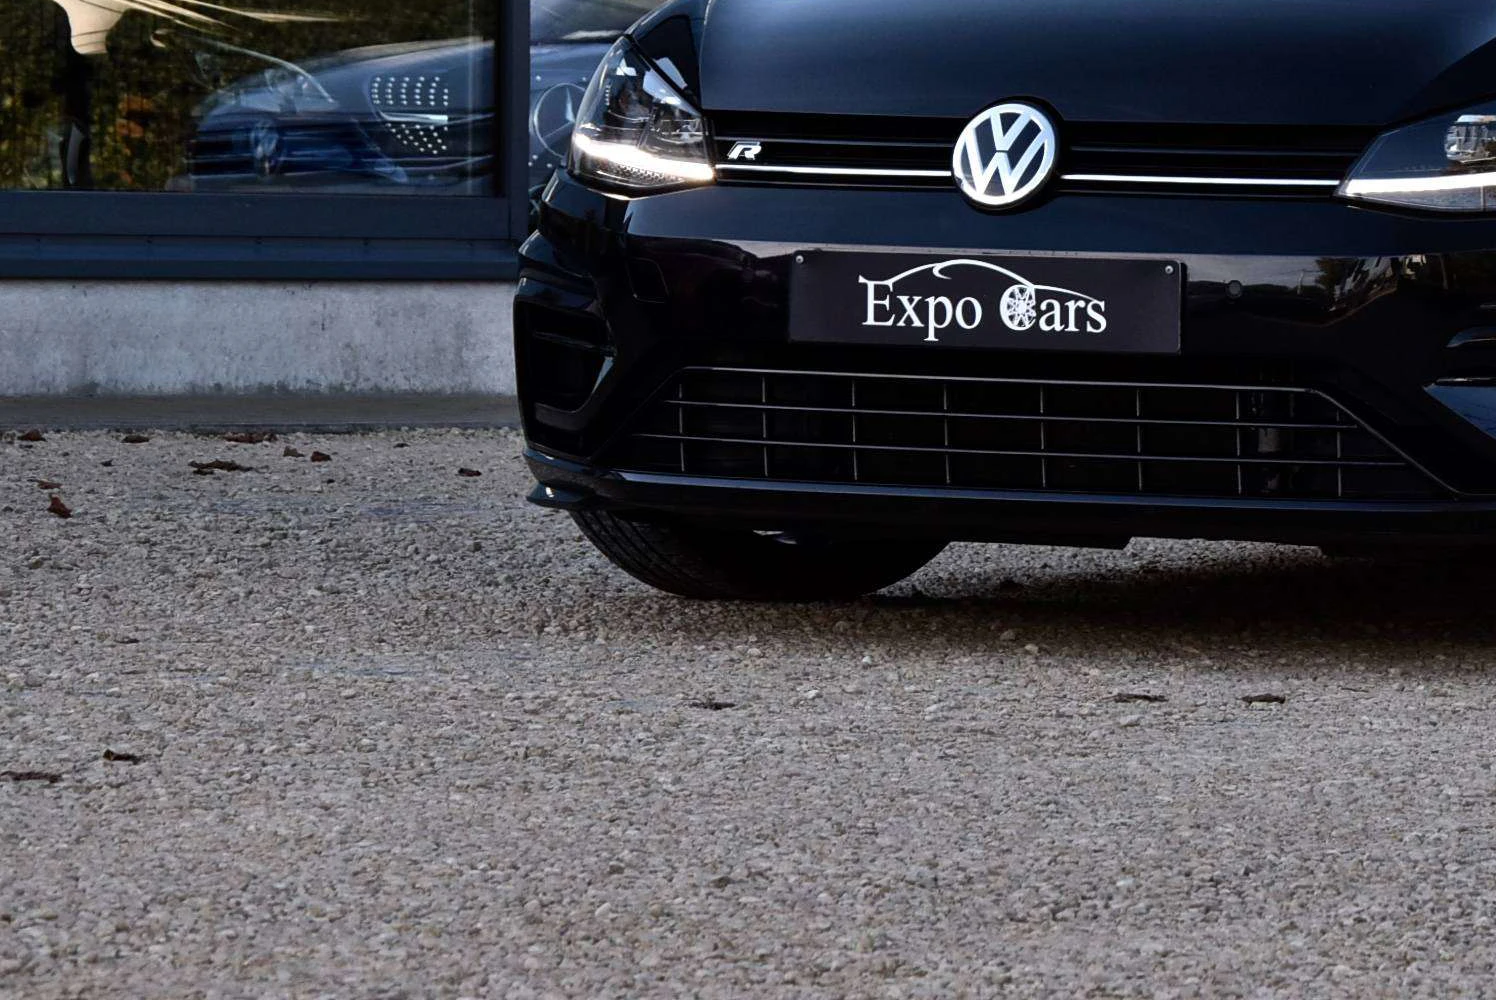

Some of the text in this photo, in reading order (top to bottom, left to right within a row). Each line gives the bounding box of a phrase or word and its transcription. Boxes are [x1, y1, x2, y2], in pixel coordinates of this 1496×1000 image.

[727, 141, 762, 160] R
[953, 103, 1056, 206] VW
[859, 276, 1107, 342] Expo Cars
